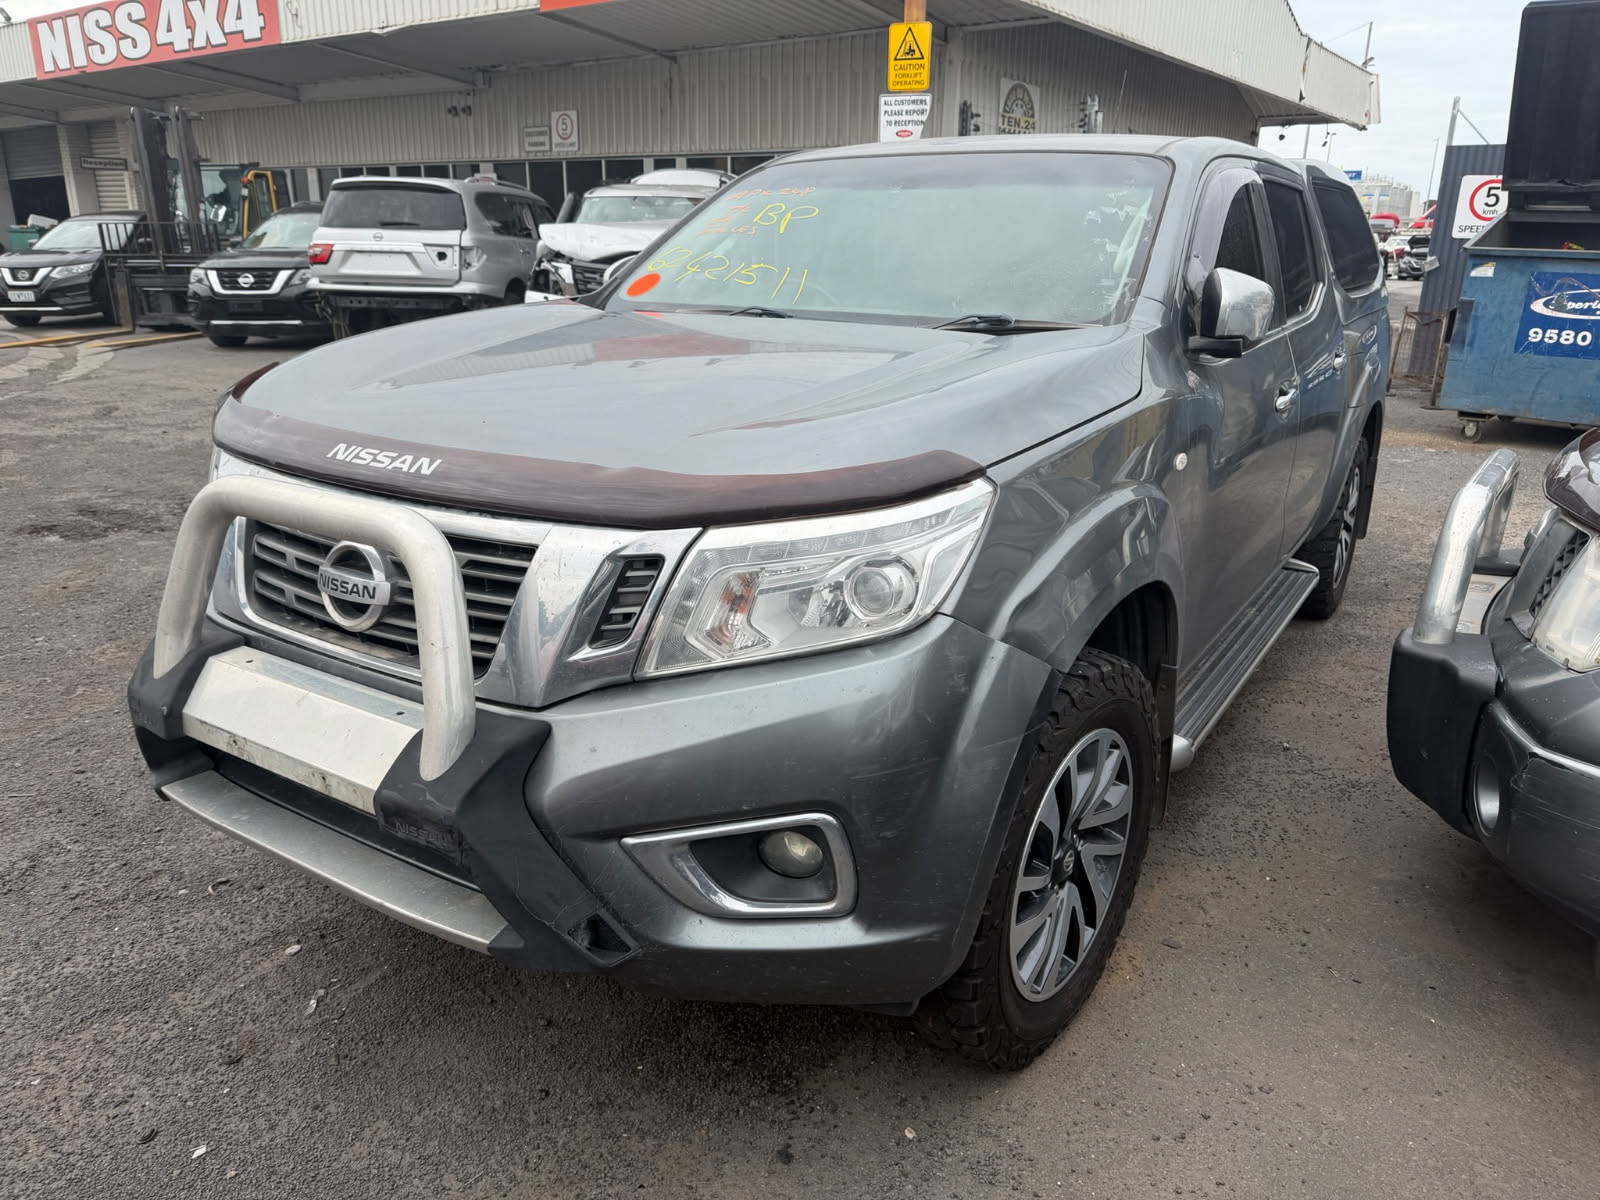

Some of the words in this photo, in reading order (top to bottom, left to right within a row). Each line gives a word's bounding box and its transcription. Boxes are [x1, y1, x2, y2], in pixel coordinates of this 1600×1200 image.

[893, 63, 925, 71] CAUTION
[561, 117, 568, 132] 5
[1484, 186, 1501, 207] 5
[753, 203, 819, 233] BP
[1458, 225, 1484, 233] SPEE
[1527, 327, 1592, 346] 9580
[327, 443, 442, 476] NISSAN
[318, 572, 377, 600] NISSAN
